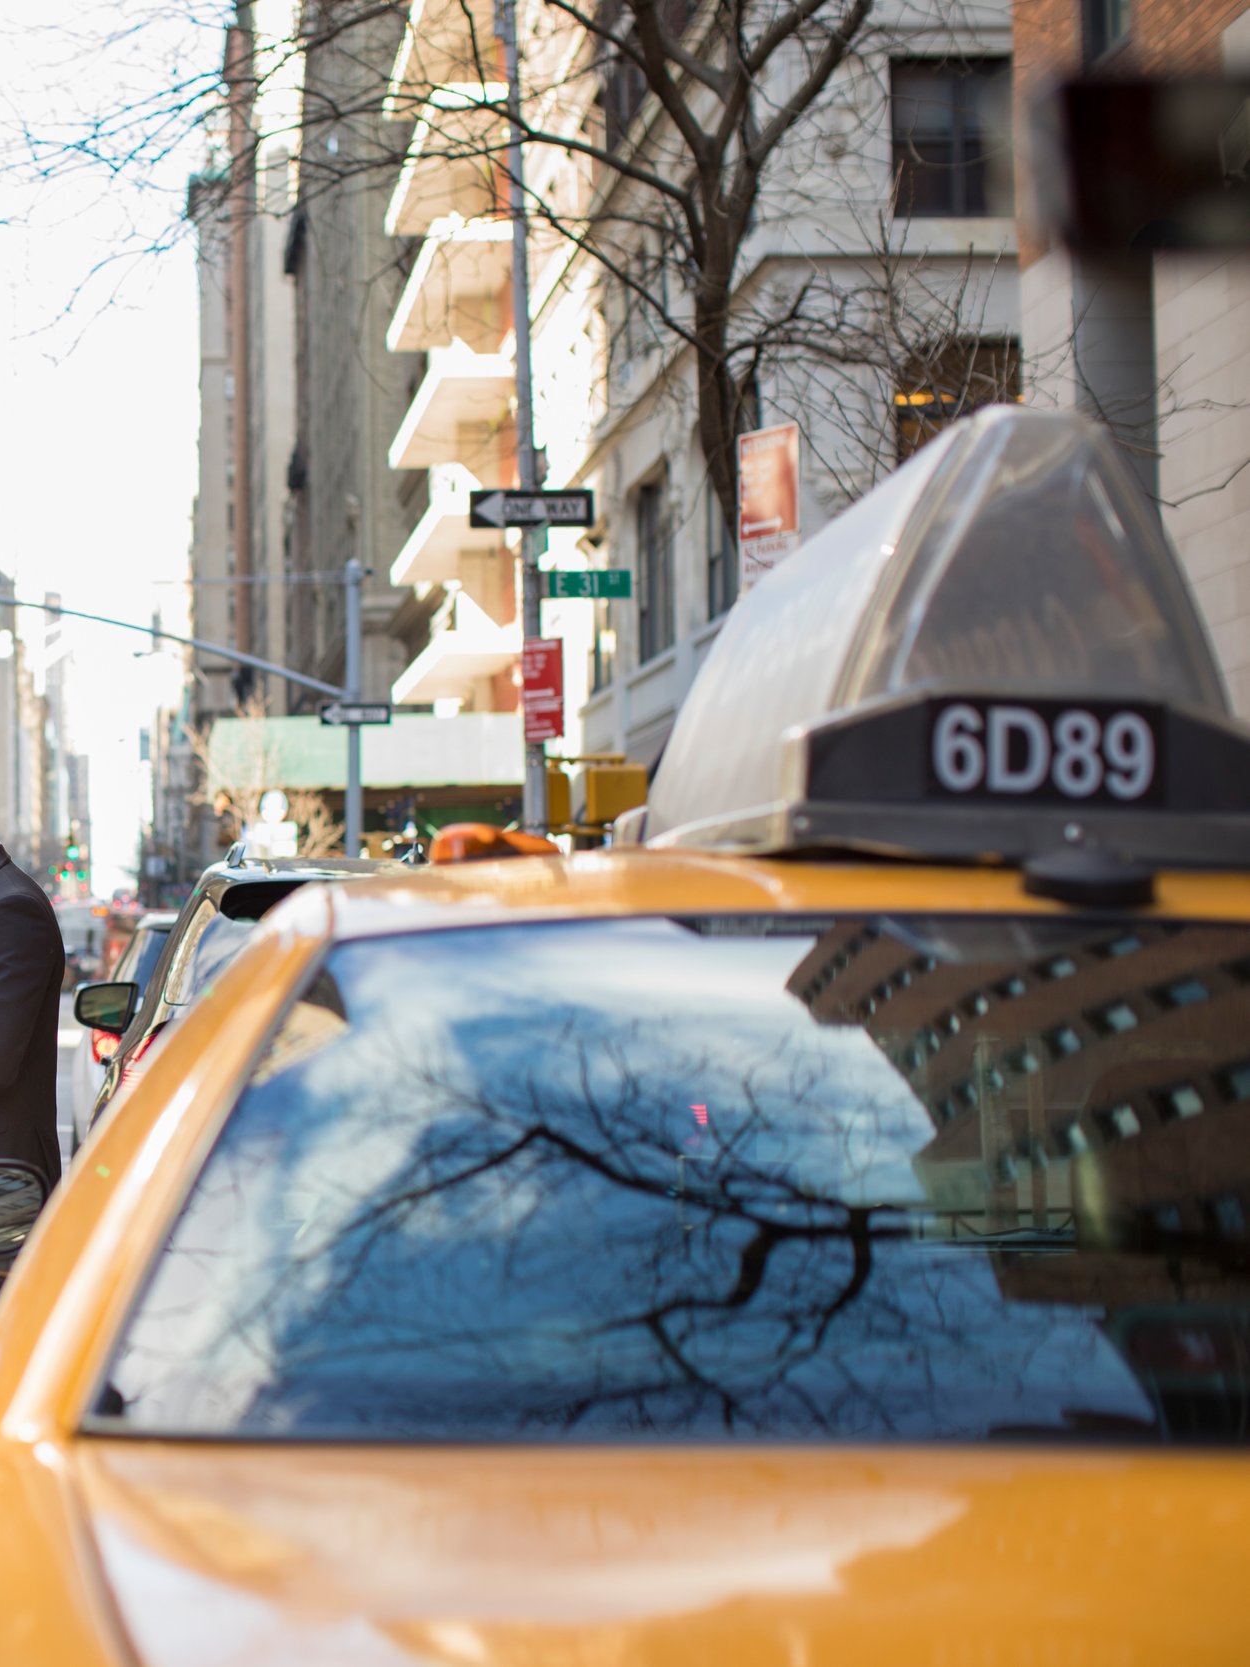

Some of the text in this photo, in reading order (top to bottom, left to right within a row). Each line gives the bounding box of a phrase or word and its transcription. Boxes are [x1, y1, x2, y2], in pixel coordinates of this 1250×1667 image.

[503, 499, 581, 515] ONE WAY
[556, 573, 568, 596] E
[578, 573, 599, 596] 31
[931, 703, 1156, 800] 6D89
